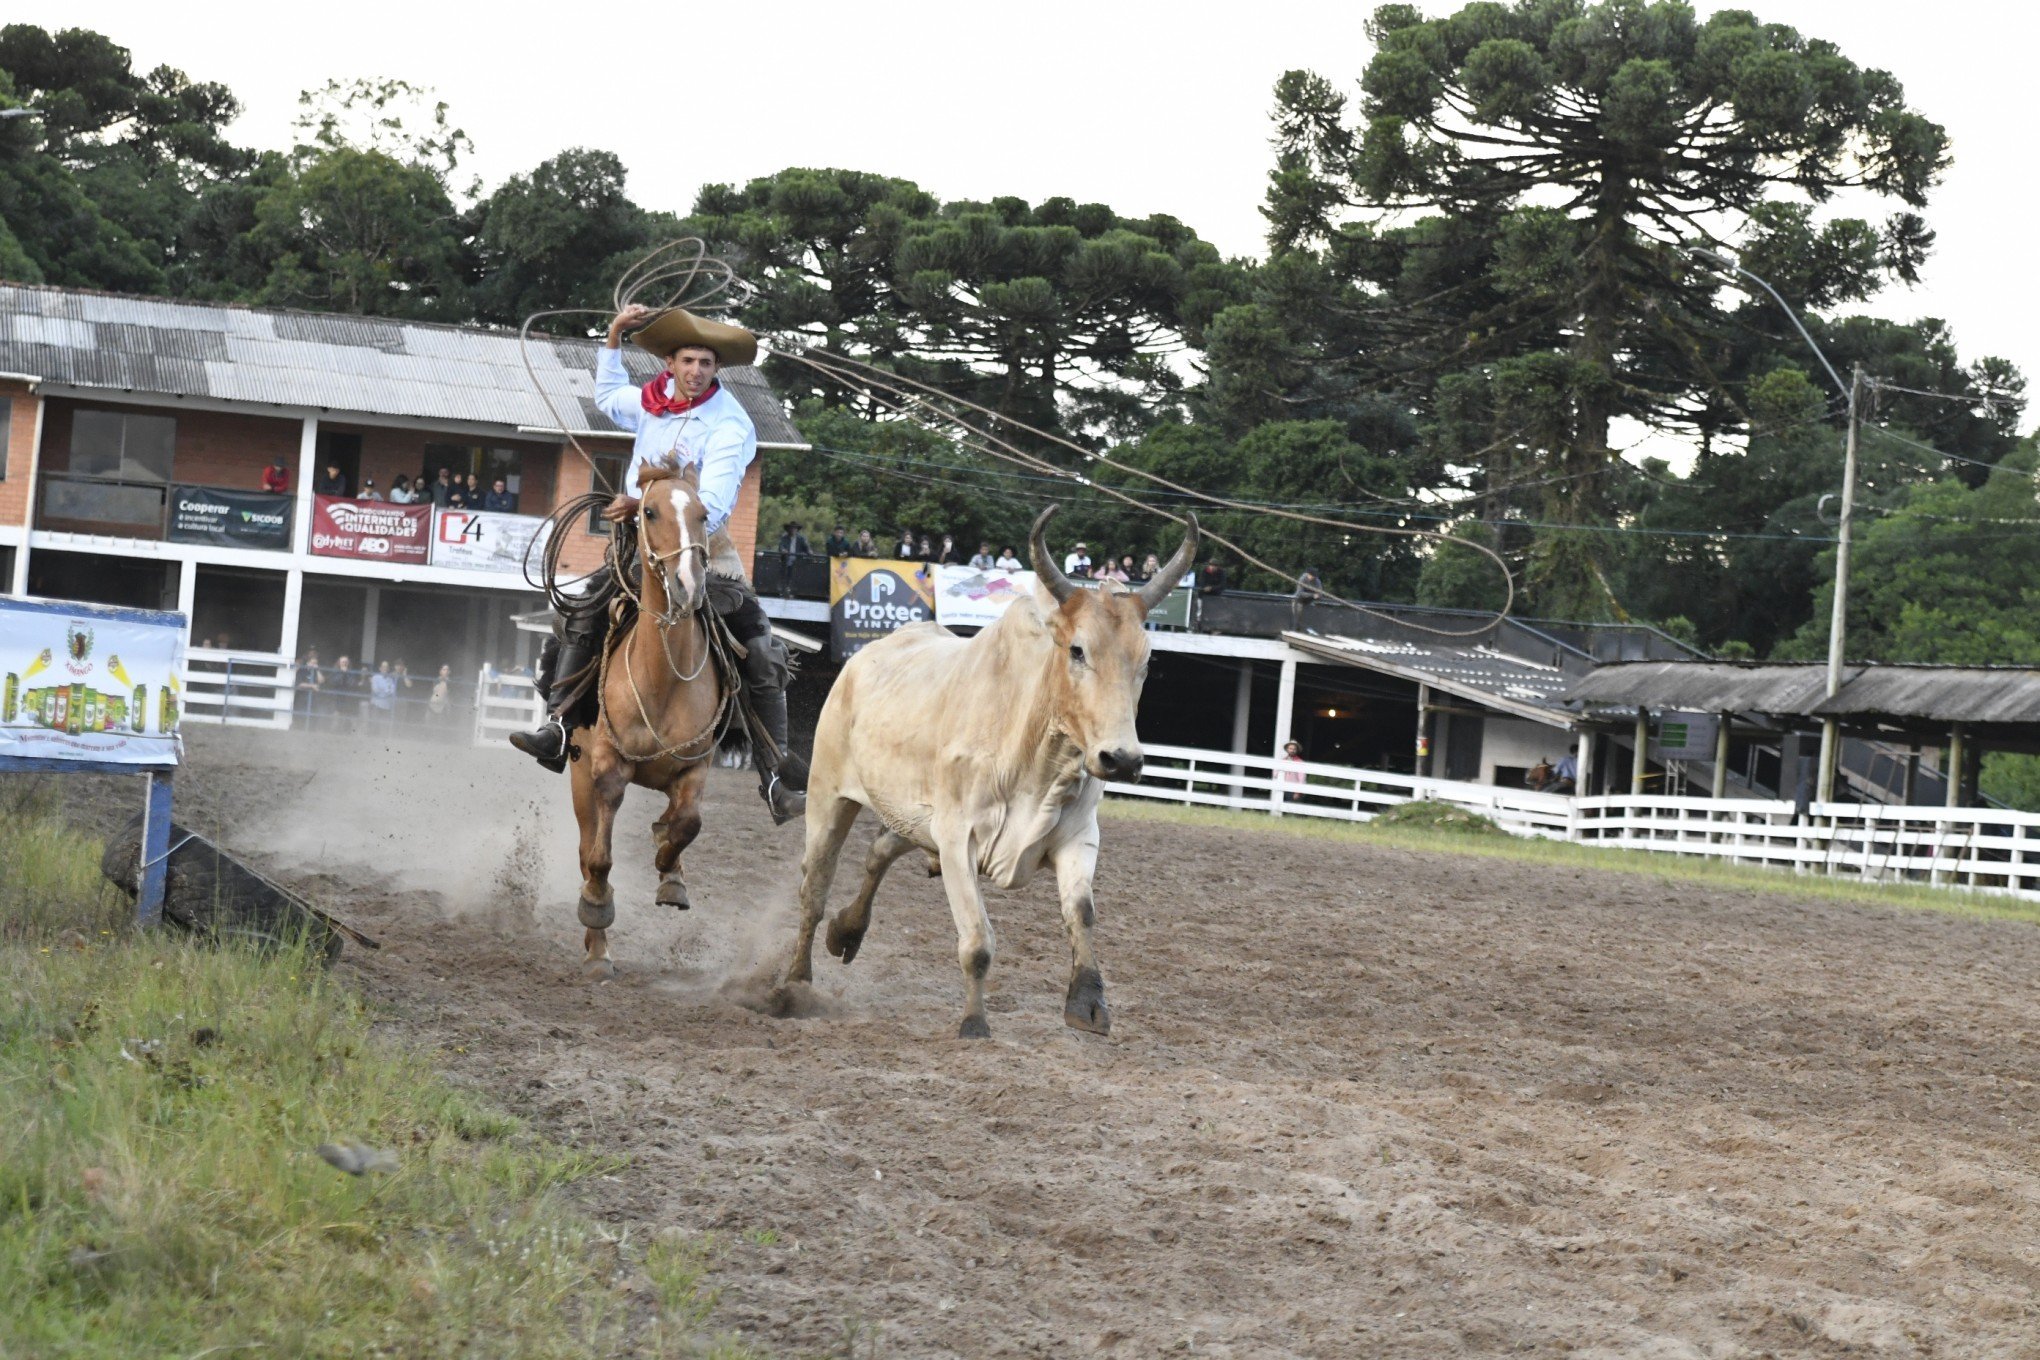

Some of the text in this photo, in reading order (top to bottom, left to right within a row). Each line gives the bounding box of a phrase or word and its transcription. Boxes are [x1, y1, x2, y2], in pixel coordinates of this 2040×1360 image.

[179, 500, 230, 515] Cooperar
[185, 514, 218, 523] incentivar
[251, 513, 284, 525] SICOOB
[344, 513, 418, 527] INTERNET DE
[184, 522, 208, 531] cultura
[208, 525, 226, 533] local
[344, 523, 417, 537] QUALIDADE?
[843, 599, 922, 622] Protec
